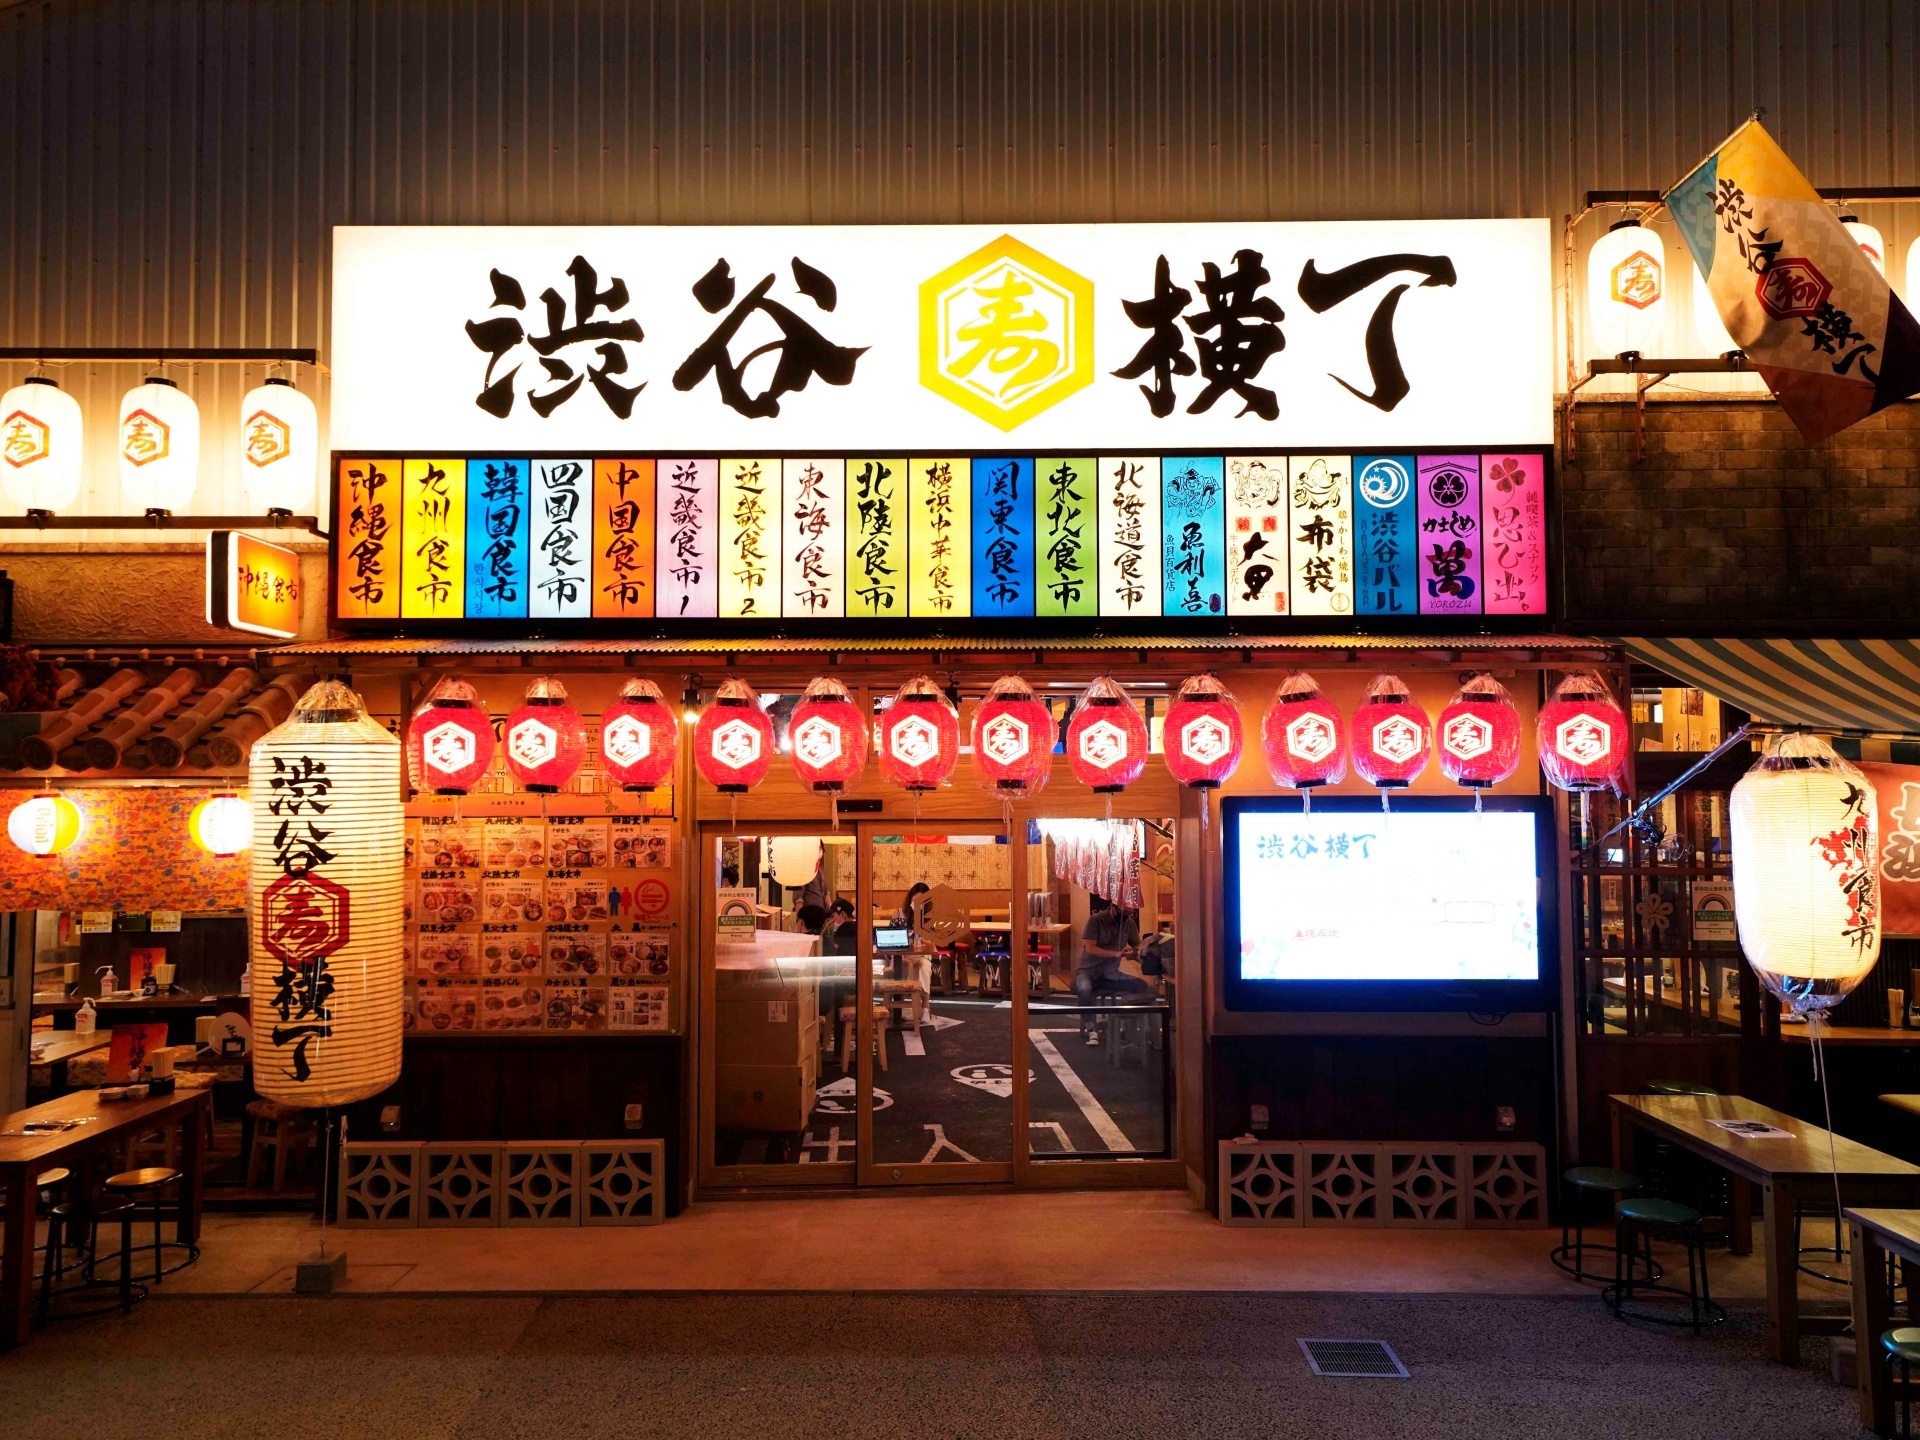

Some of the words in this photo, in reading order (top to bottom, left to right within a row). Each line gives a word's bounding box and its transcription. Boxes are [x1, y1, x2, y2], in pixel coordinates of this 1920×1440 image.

[1705, 178, 1783, 275] 渋谷
[465, 256, 872, 419] 渋谷
[1112, 249, 1457, 420] 横丁
[348, 462, 393, 615] 沖縄食市
[416, 462, 452, 614] 九州食市
[480, 461, 524, 616] 韓国食市
[537, 461, 585, 613] 四国食市
[603, 461, 644, 614] 中国食市
[794, 462, 832, 614] 東海食市
[855, 461, 898, 616] 北陸食市
[925, 462, 955, 613] 横浜中華食市
[985, 461, 1020, 611] 関東食市
[1047, 461, 1087, 613] 東北食市
[1113, 461, 1146, 611] 北海道食市
[1296, 514, 1337, 593] 布袋
[1371, 511, 1403, 611] 渋谷バル
[1430, 600, 1472, 609] YOROZU
[269, 755, 339, 878] 渋谷
[1256, 832, 1377, 859] 渋谷横丁
[1839, 781, 1876, 962] 九州食市
[1304, 928, 1339, 938] 現在地
[270, 956, 335, 1081] 横丁
